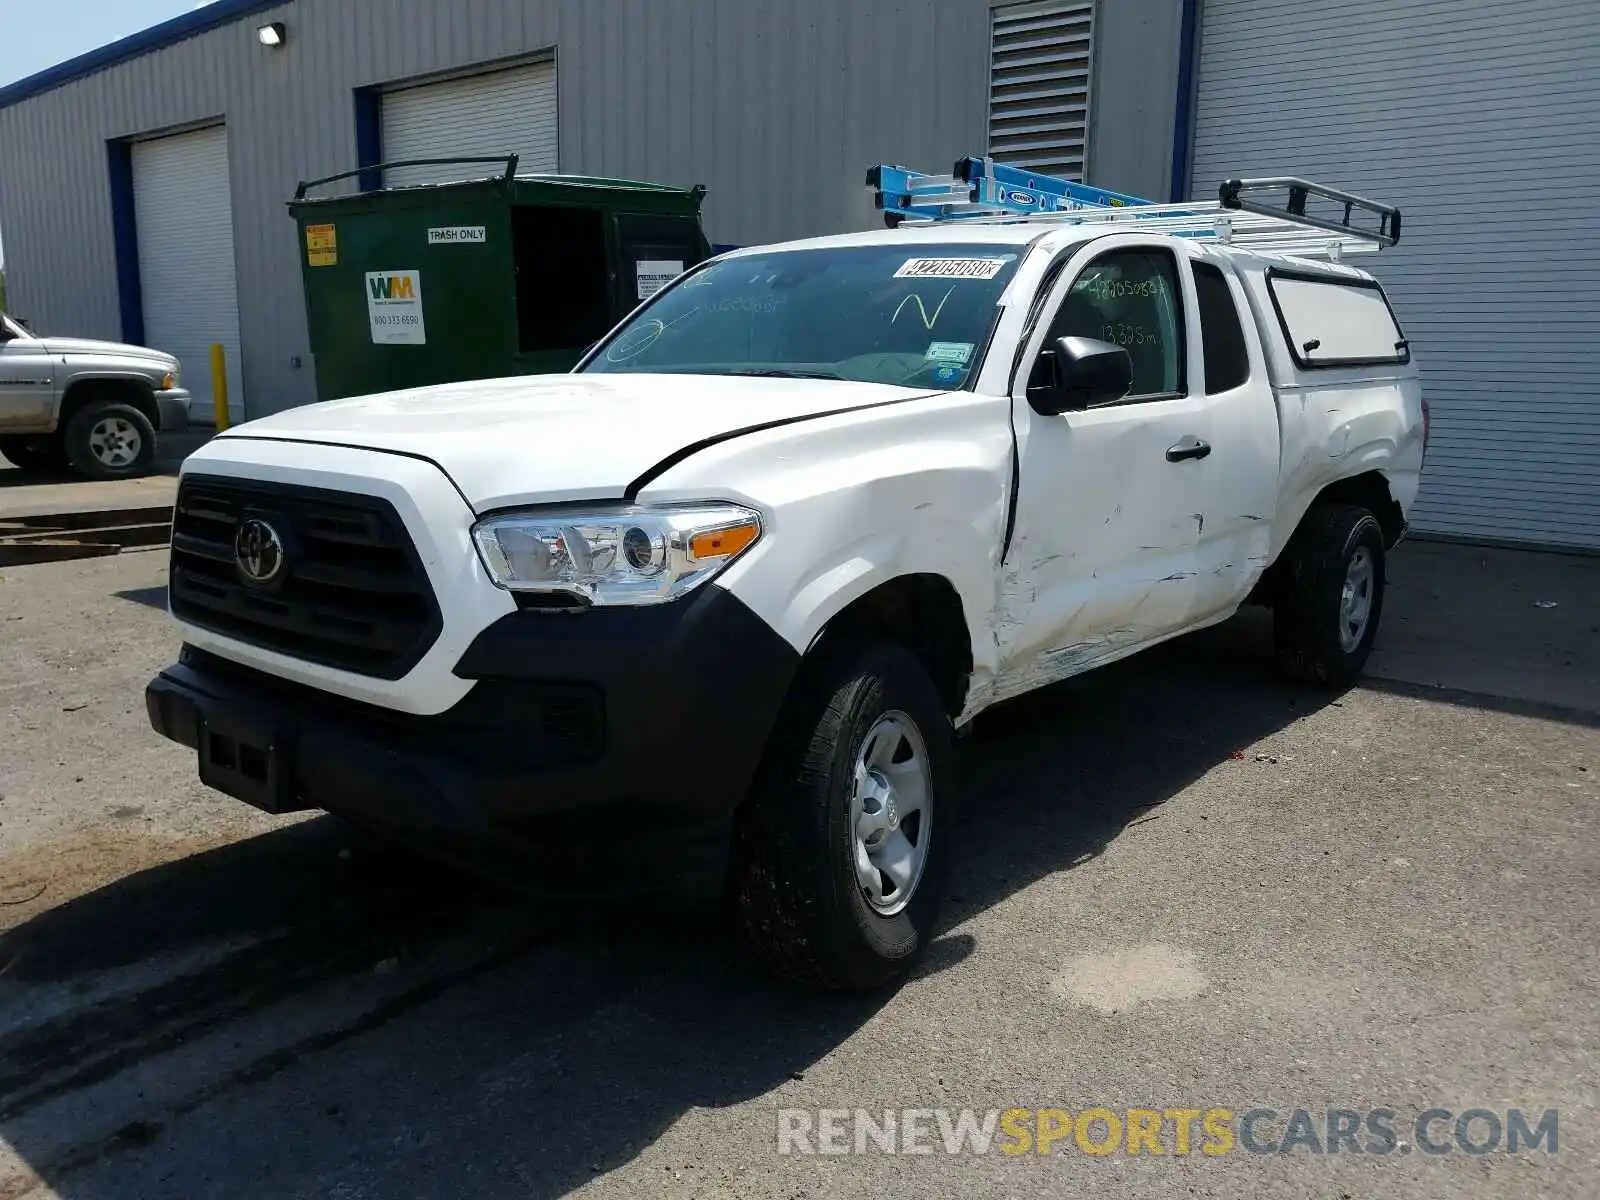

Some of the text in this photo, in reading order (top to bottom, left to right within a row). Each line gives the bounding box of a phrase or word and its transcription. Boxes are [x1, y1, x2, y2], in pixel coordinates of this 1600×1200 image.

[430, 229, 483, 240] TRASH ONLY
[370, 277, 416, 298] WM
